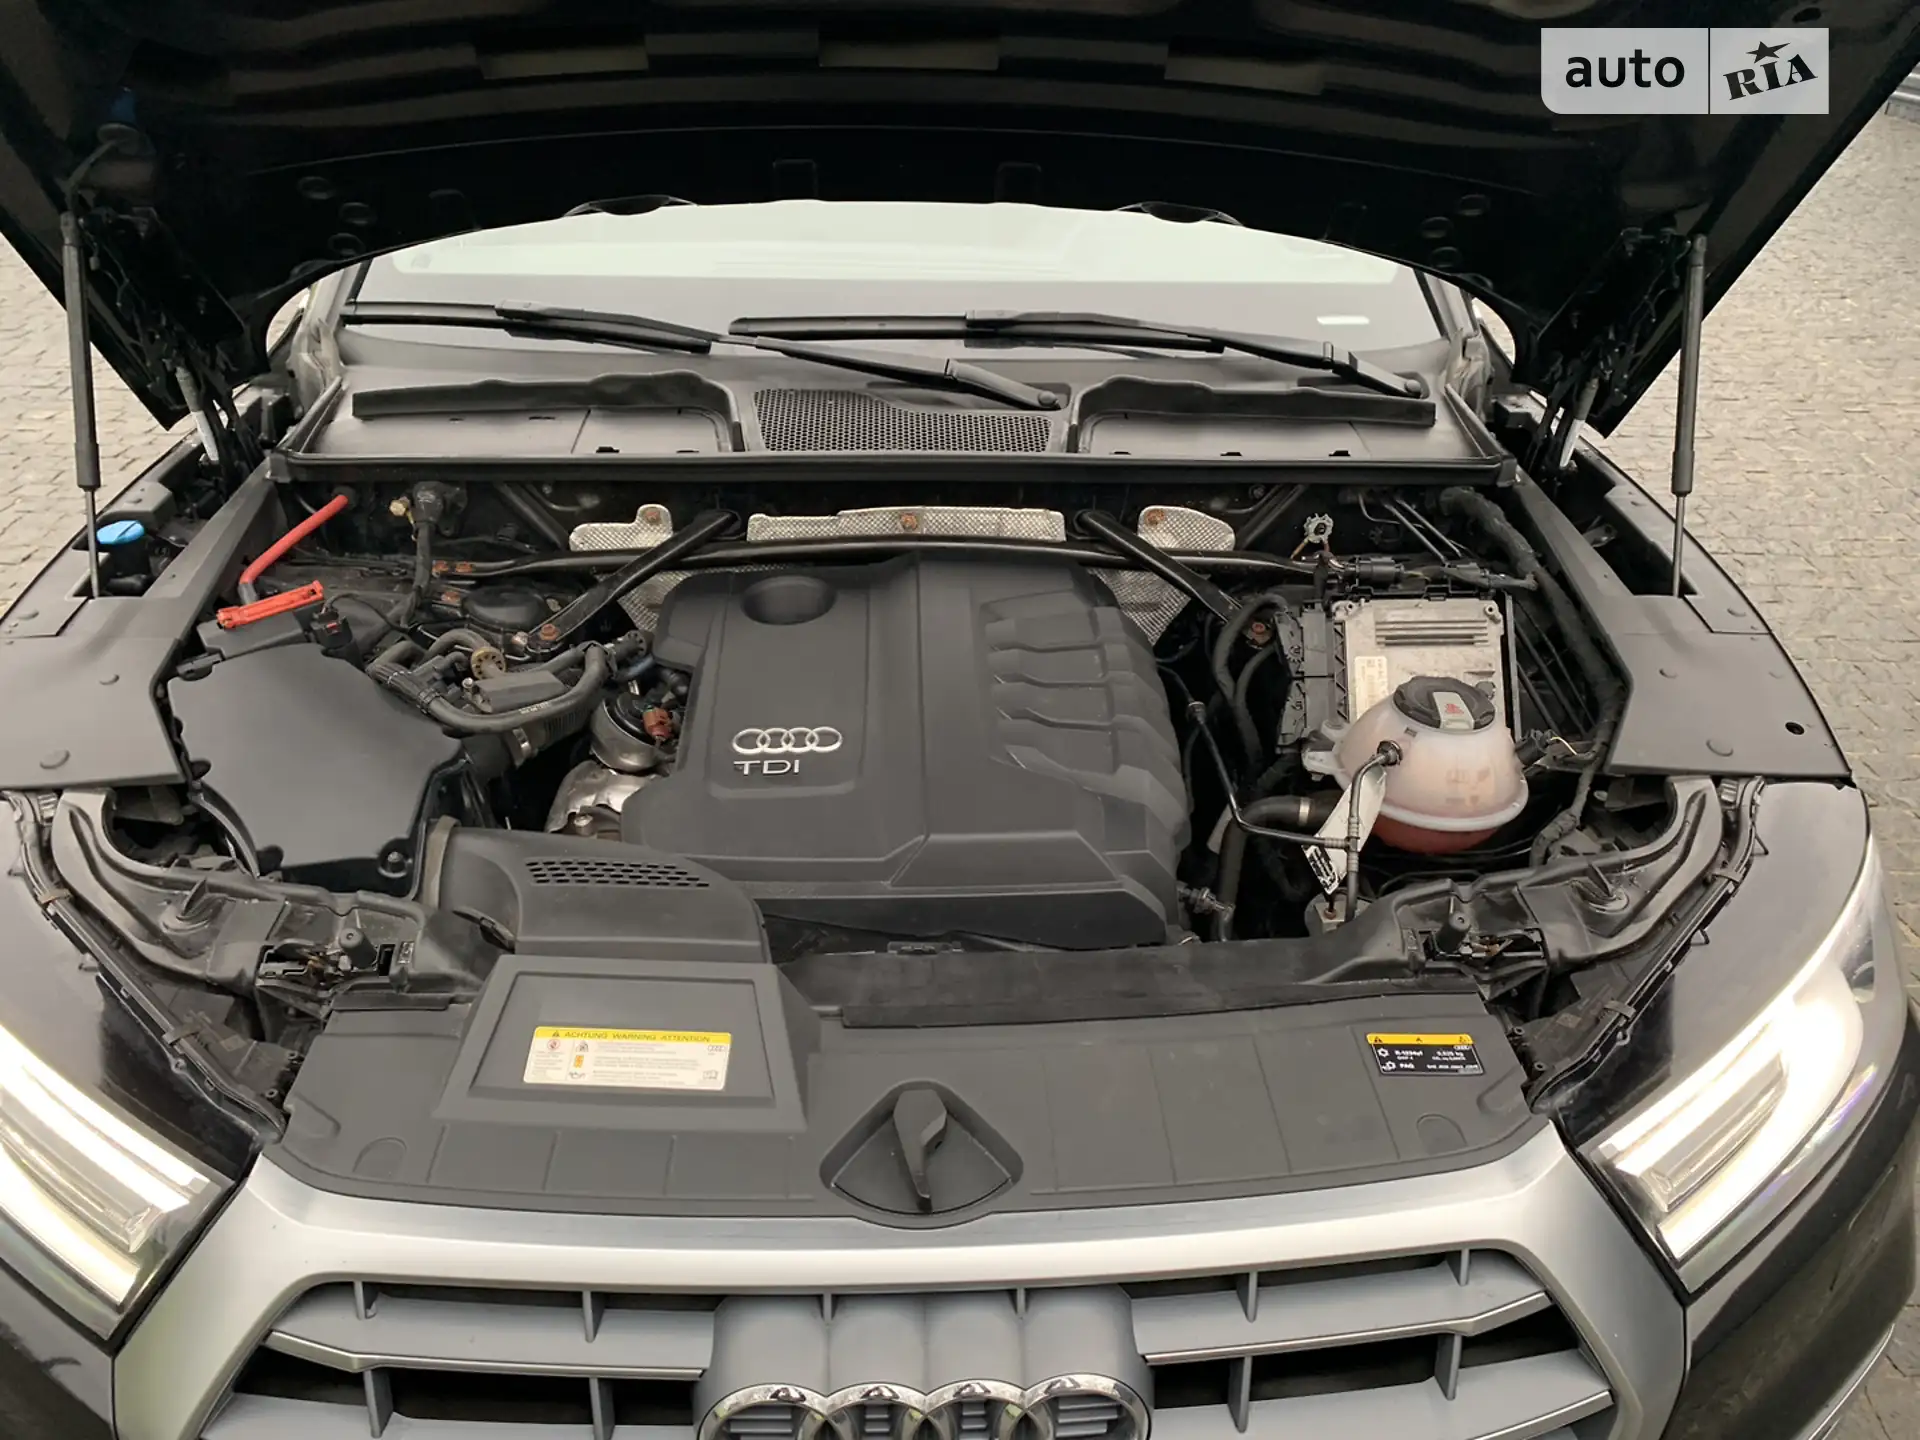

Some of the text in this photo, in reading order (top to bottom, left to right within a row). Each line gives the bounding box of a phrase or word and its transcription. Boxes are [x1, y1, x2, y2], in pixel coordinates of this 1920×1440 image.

[733, 759, 800, 776] TDI
[564, 1031, 608, 1039] ACHTUNG
[612, 1033, 656, 1041] WARNING
